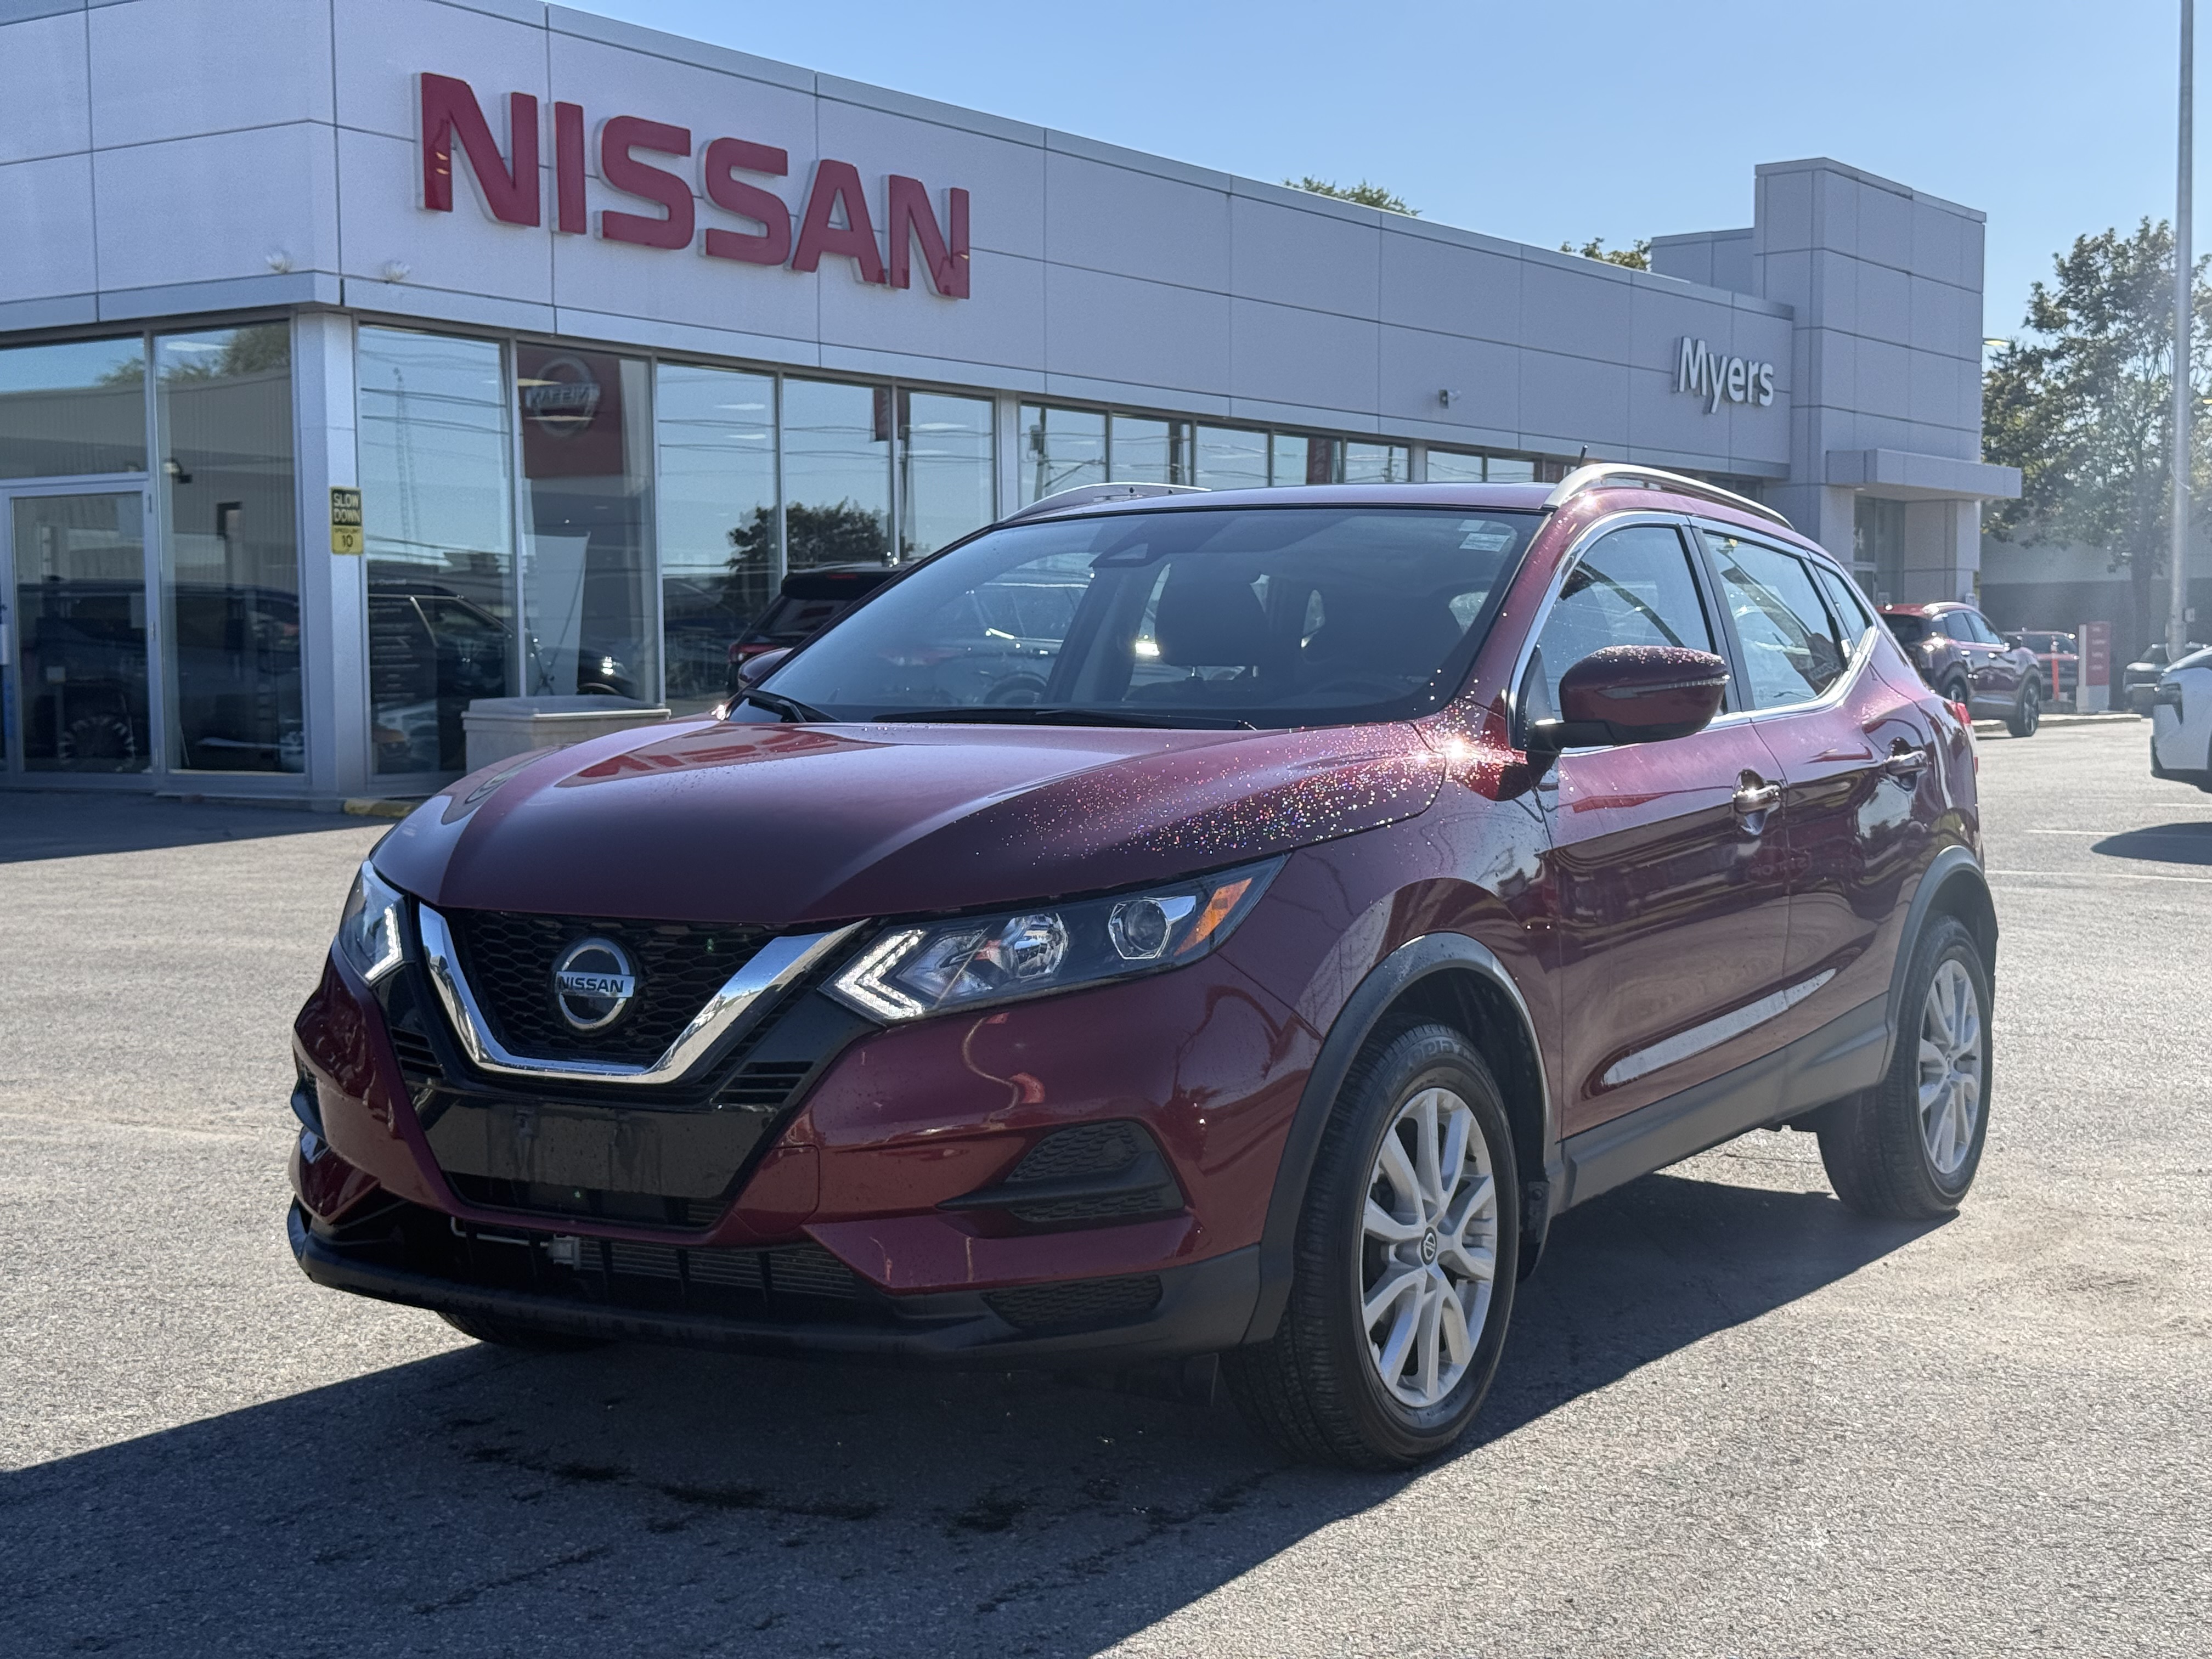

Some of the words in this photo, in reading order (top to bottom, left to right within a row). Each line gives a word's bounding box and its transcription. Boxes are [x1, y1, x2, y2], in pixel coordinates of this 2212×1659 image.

[417, 72, 970, 300] NISSAN
[1678, 336, 1774, 414] Myers
[333, 493, 359, 507] SLOW
[334, 508, 360, 523] DOWN
[342, 534, 354, 548] 10
[557, 976, 624, 992] NISSAN
